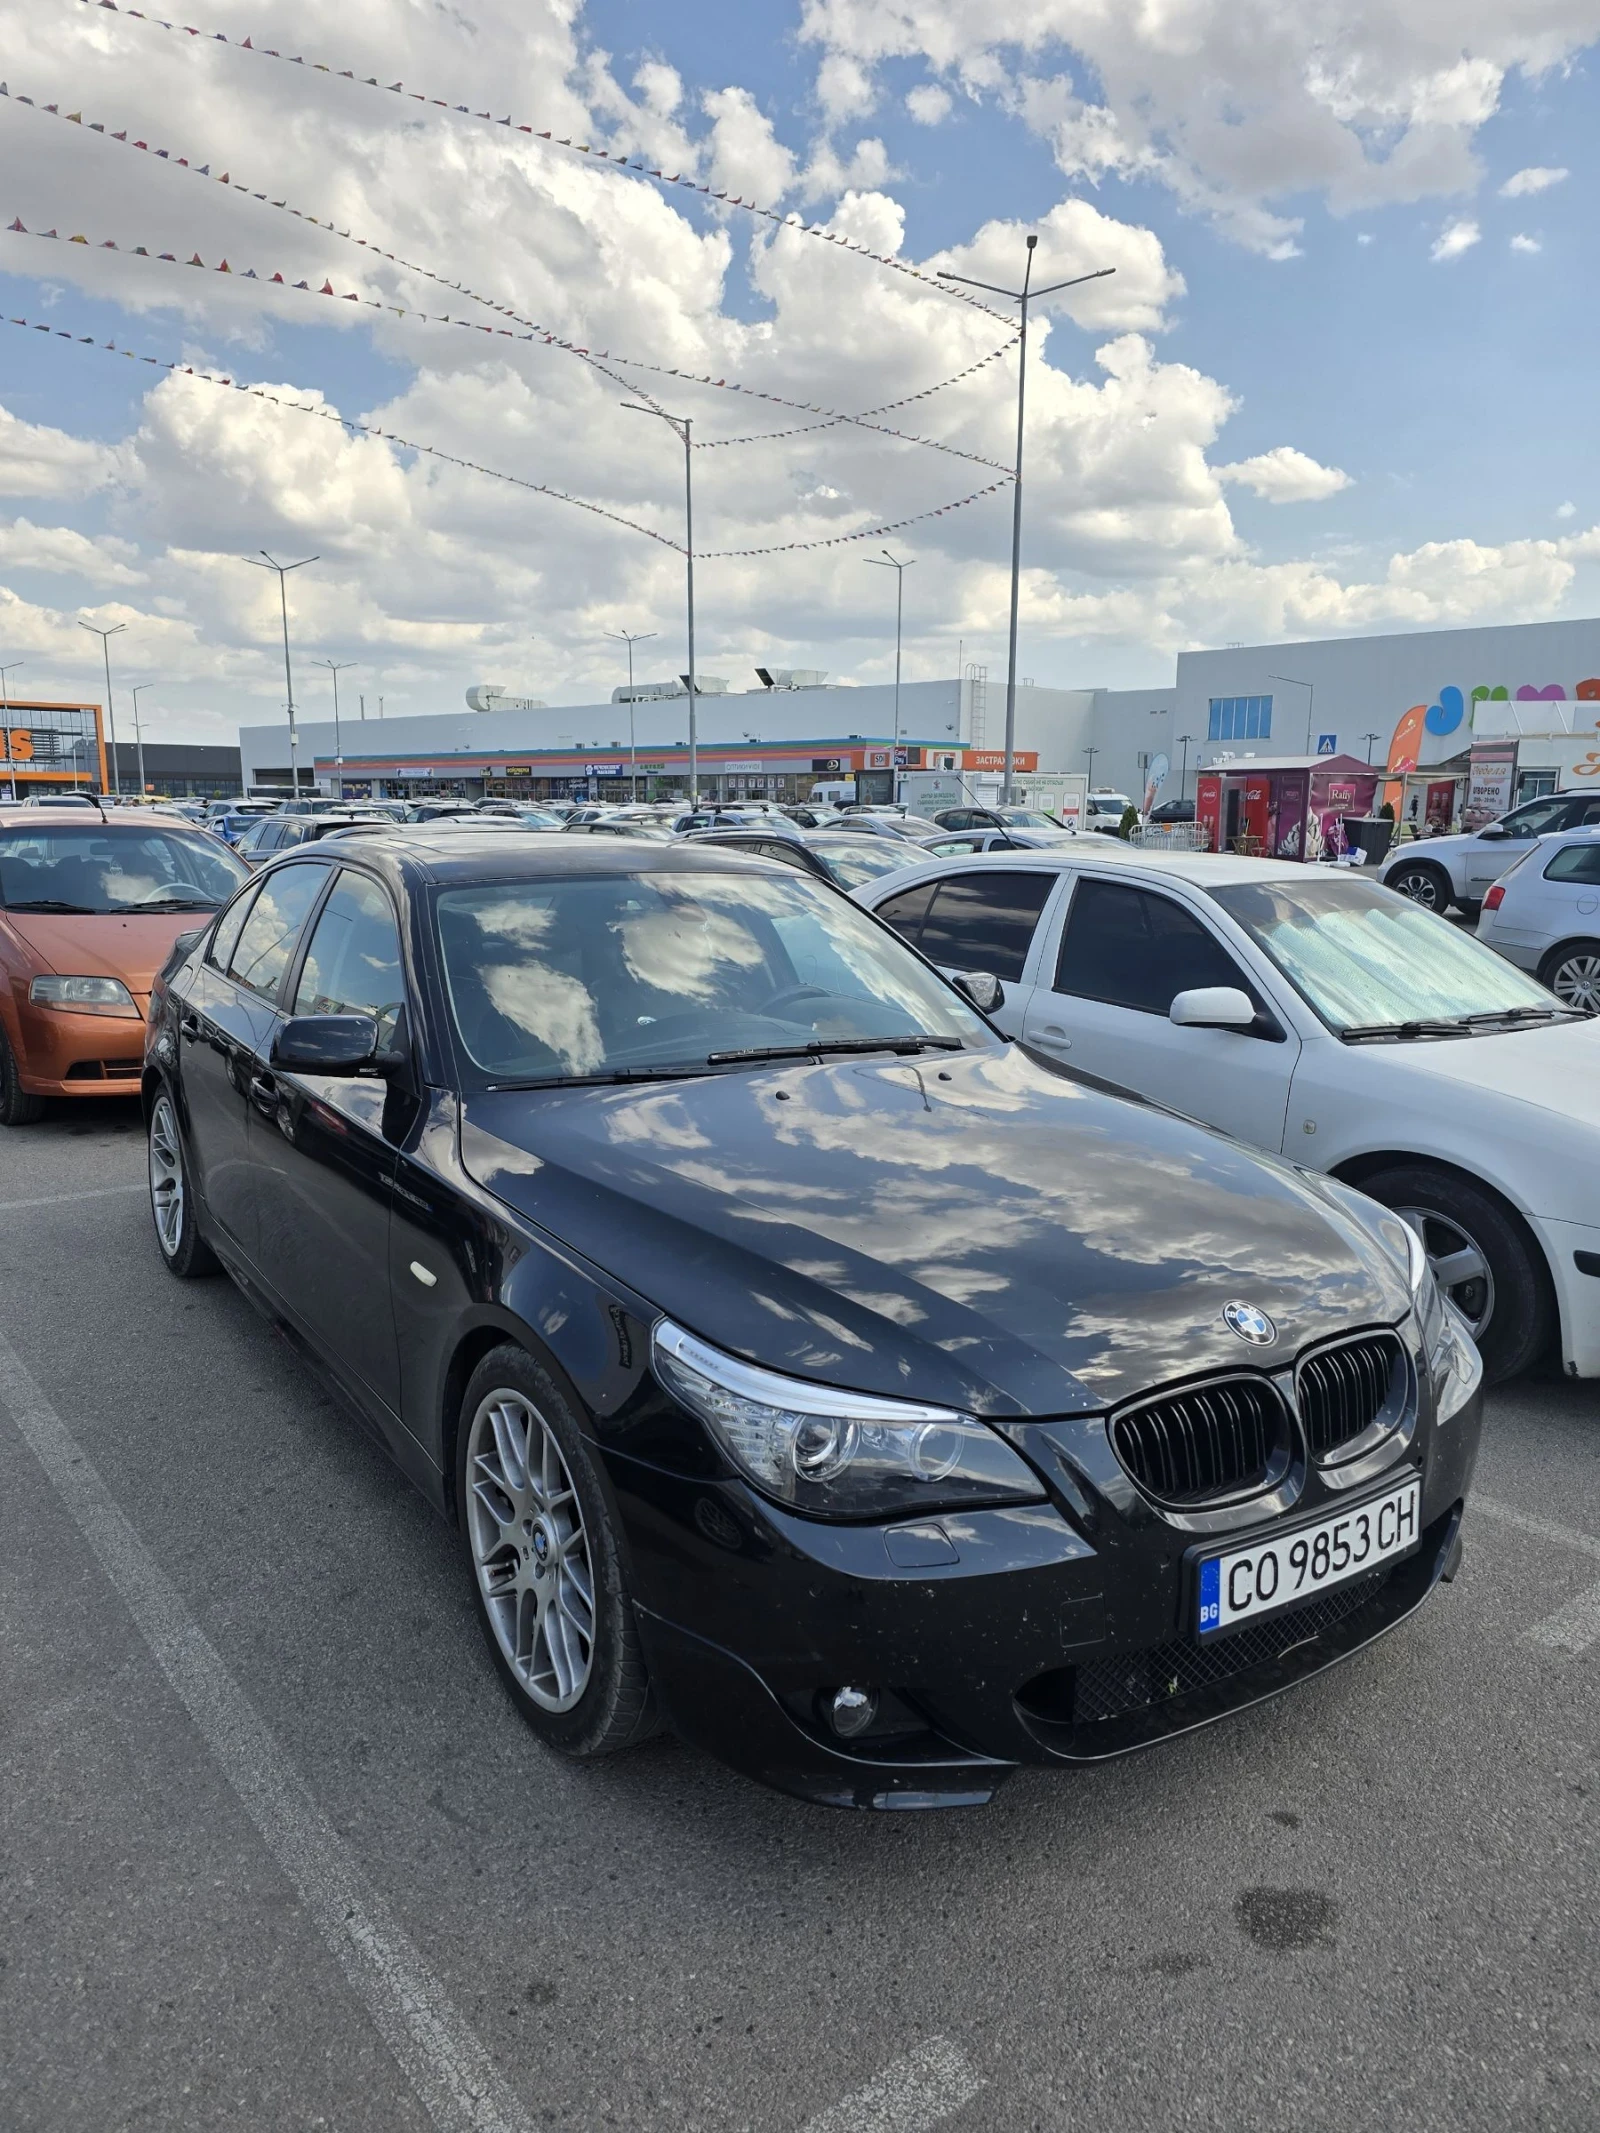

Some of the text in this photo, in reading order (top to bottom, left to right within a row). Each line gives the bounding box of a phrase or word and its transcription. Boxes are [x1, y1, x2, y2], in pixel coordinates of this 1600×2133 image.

[1331, 789, 1352, 802] Raffy
[1473, 786, 1500, 796] ОТВОРЕНО
[1228, 1490, 1415, 1612] CO 9853 CH
[1200, 1603, 1218, 1623] BG
